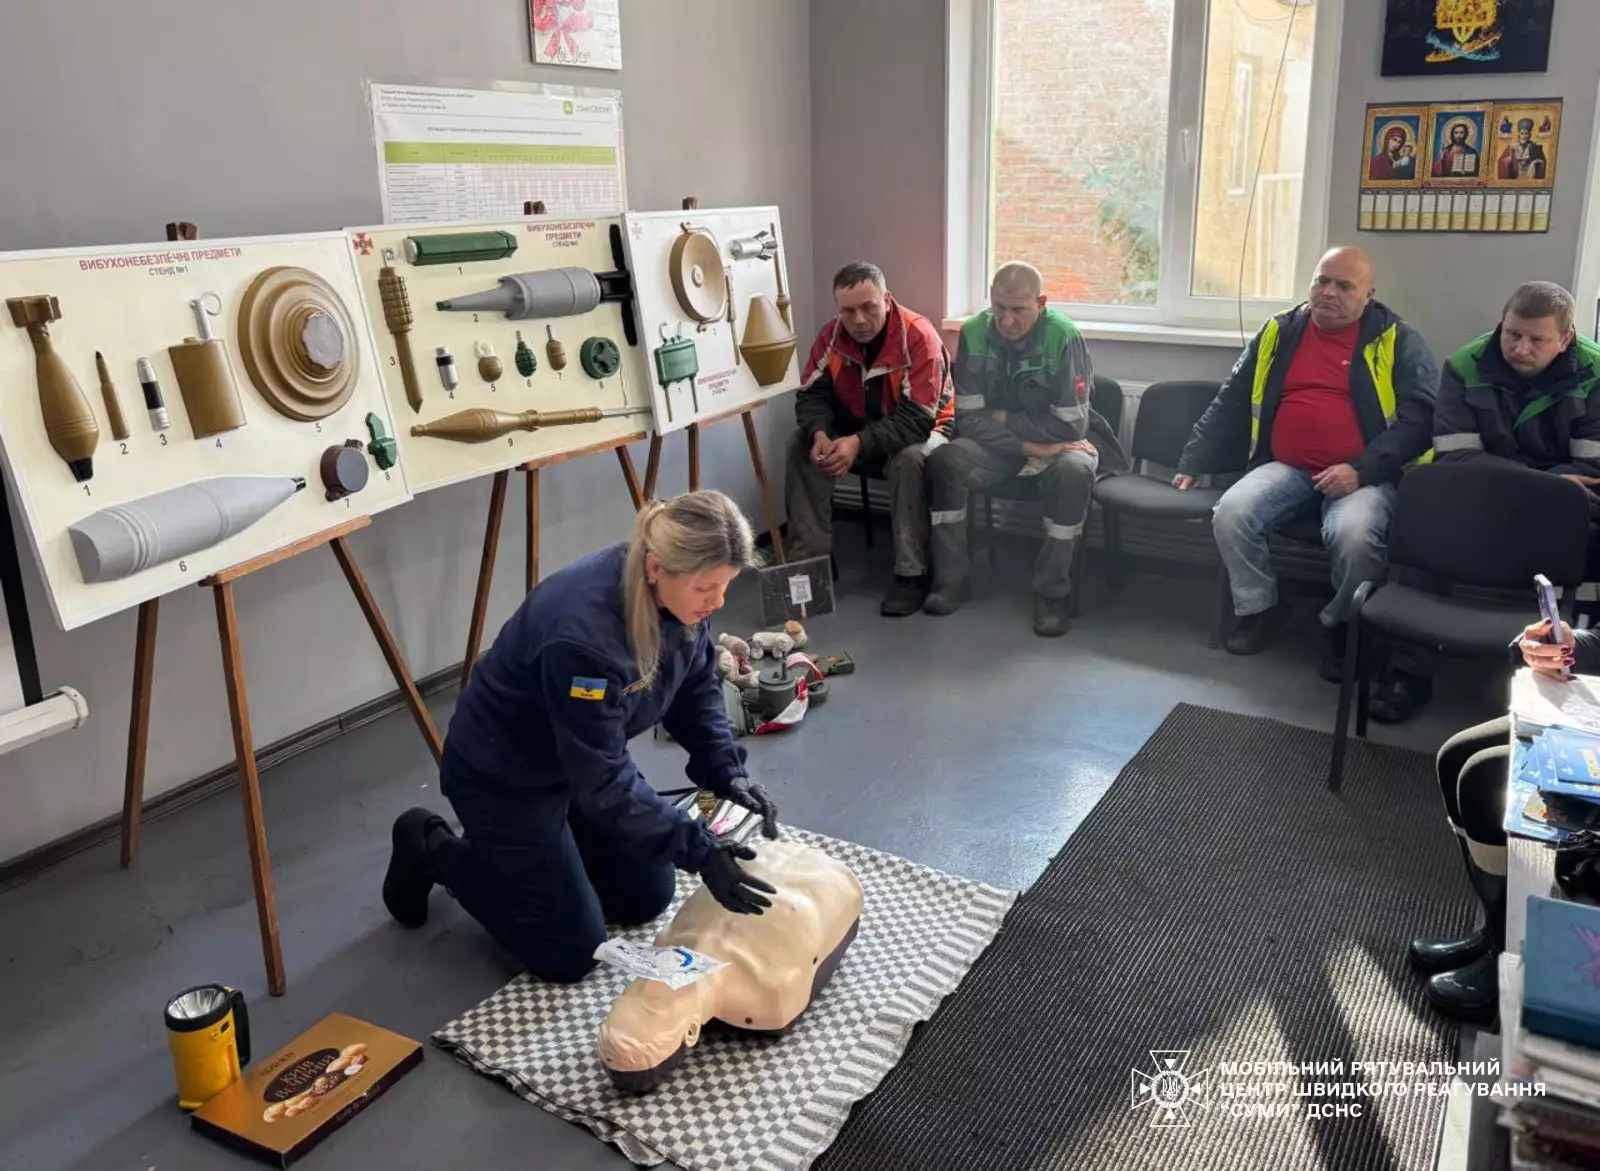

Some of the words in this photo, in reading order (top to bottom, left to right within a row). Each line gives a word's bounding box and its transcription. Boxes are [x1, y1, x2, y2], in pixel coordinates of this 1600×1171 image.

[191, 247, 242, 261] ПРЕДМЕТИ
[148, 267, 176, 276] СТЕНД
[457, 266, 463, 275] 1
[473, 314, 479, 323] 2
[390, 356, 396, 366] 3
[490, 383, 496, 392] 5
[526, 379, 532, 388] 6
[449, 391, 454, 400] 4
[315, 423, 322, 433] 5
[160, 433, 168, 446] 3
[215, 438, 222, 449] 4
[508, 438, 513, 447] 9
[119, 442, 129, 455] 2
[385, 472, 391, 481] 8
[83, 484, 91, 497] 1
[344, 498, 350, 508] 7
[179, 560, 187, 572] 6
